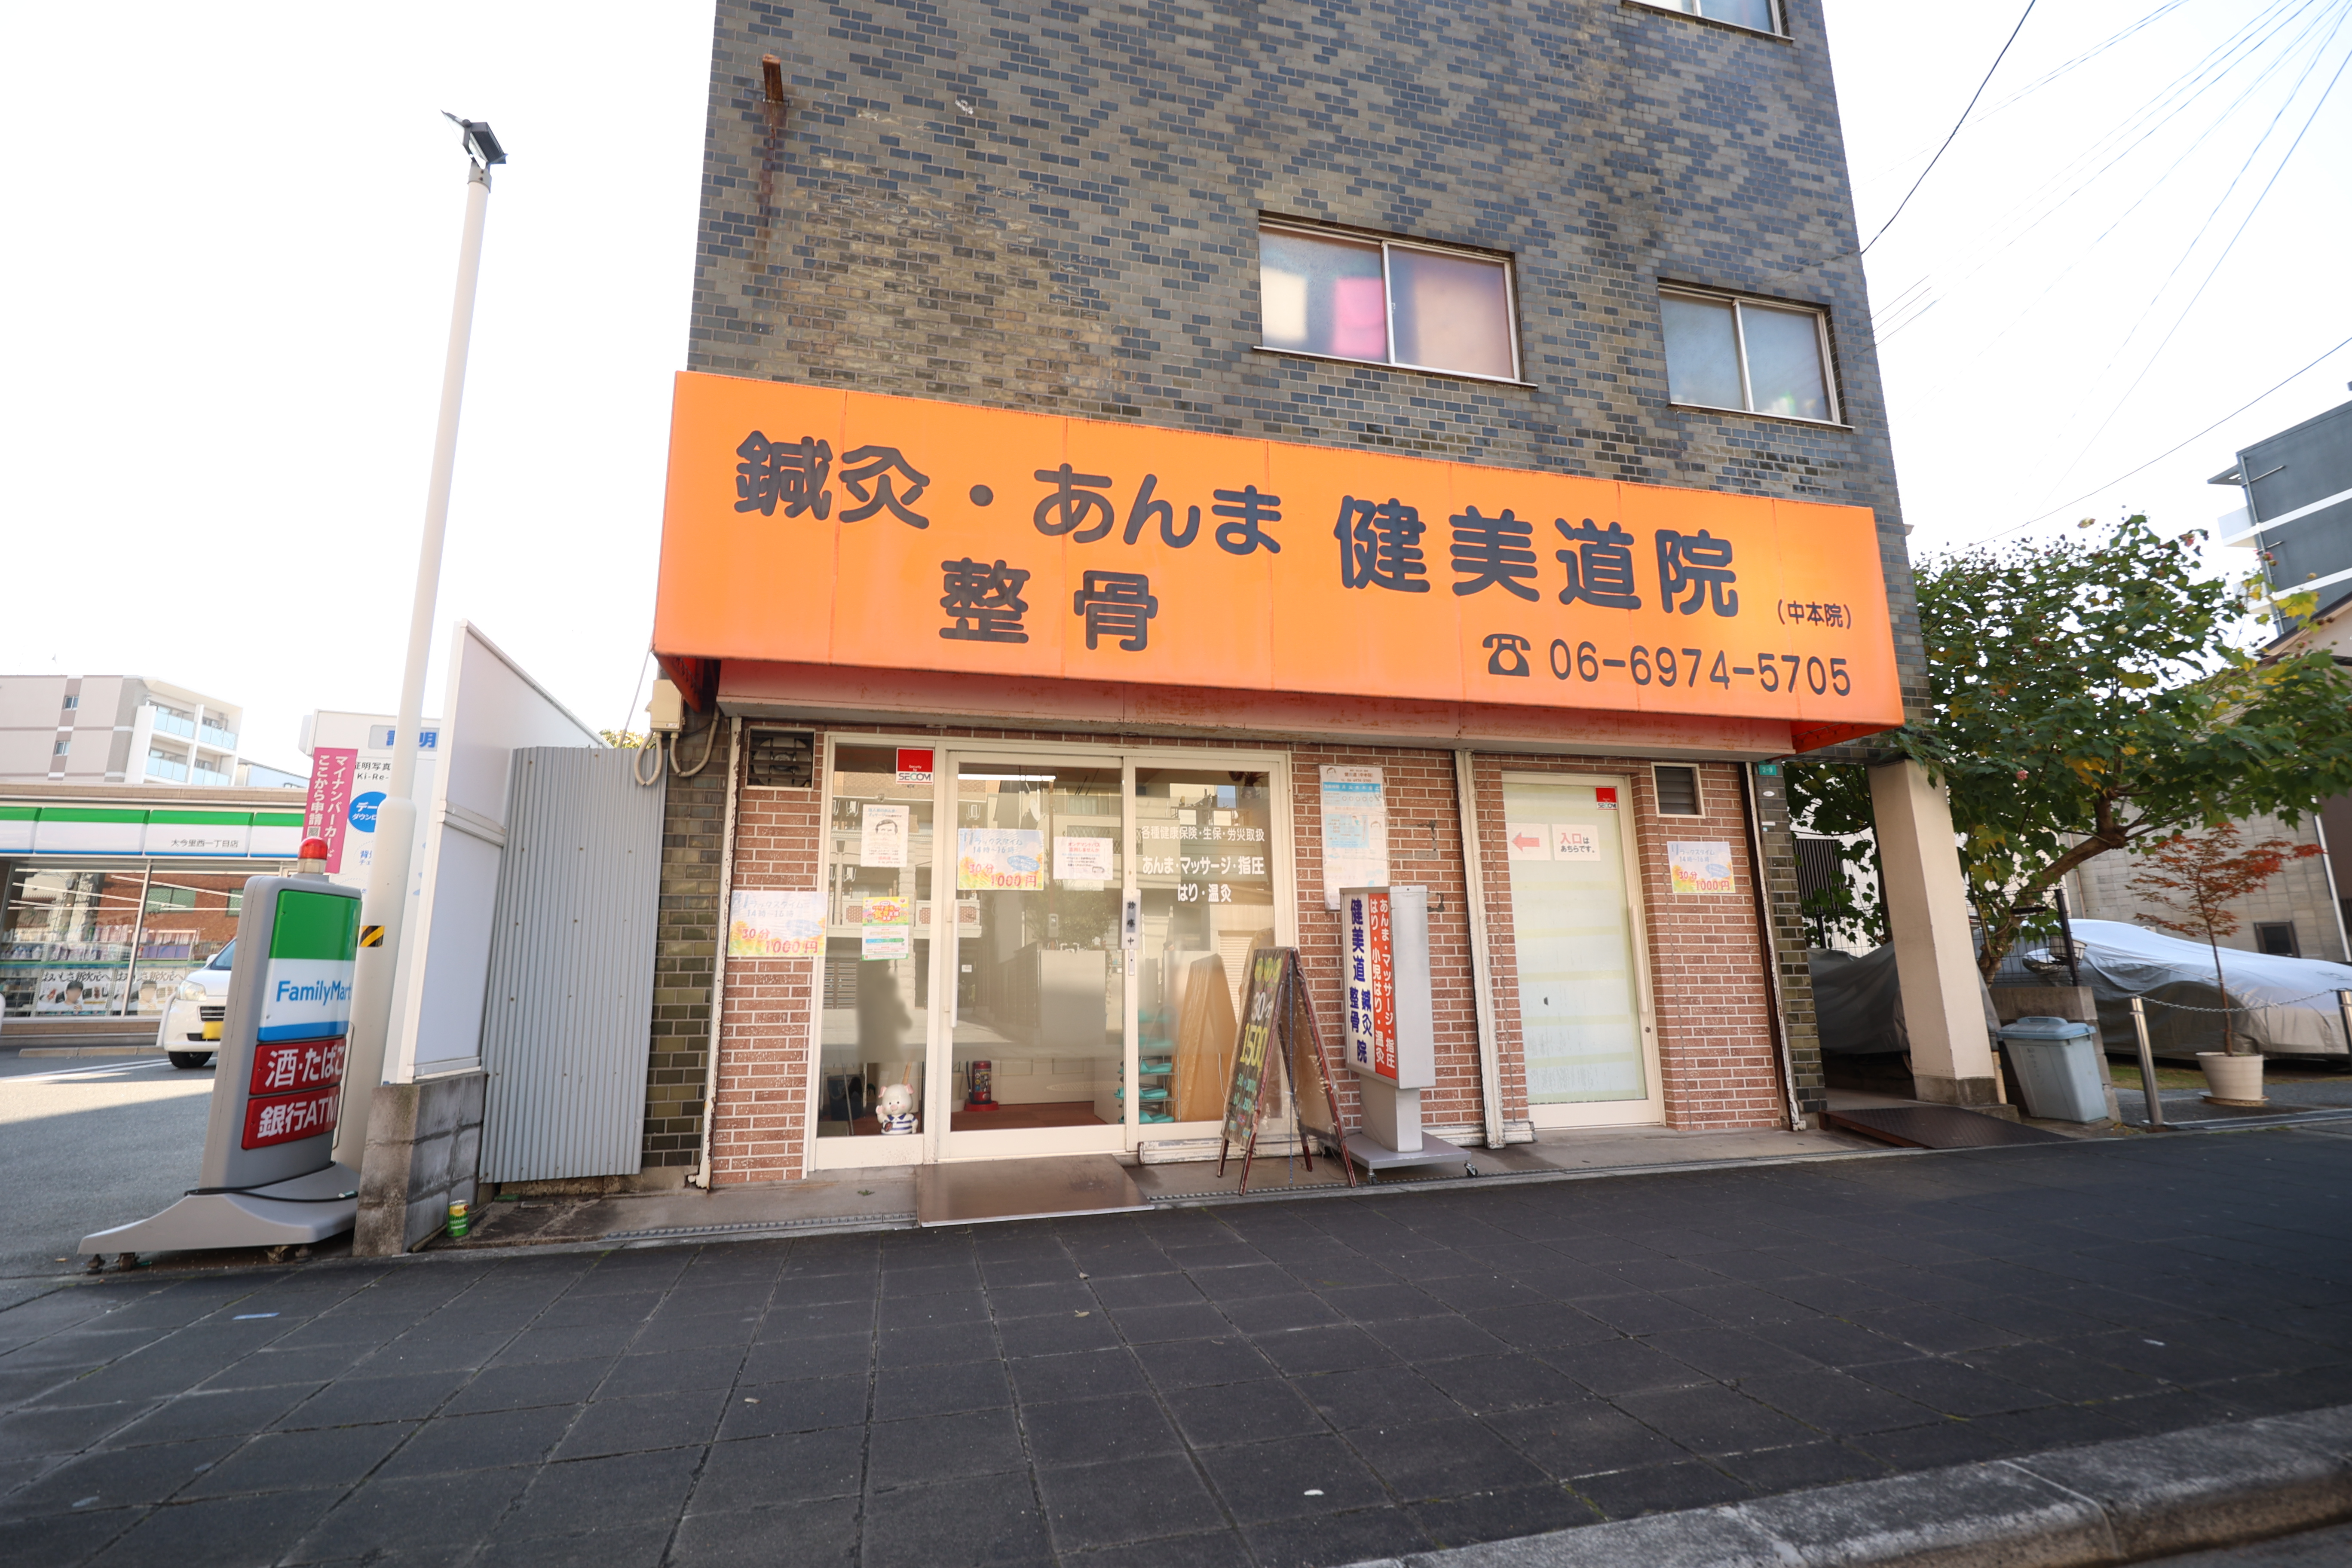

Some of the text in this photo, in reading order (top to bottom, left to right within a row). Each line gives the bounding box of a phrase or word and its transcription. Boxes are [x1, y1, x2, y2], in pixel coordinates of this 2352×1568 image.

[1334, 495, 1738, 617] 健美道院
[940, 557, 1158, 652] 整骨
[1550, 638, 1851, 697] 06-6974-5705
[899, 773, 931, 781] SECOM
[308, 755, 330, 826] ここから申請
[171, 839, 239, 848] 大今里西一丁目店
[1141, 826, 1265, 842] 各種健康保険・生保・労災取扱
[1142, 856, 1265, 875] あんま・マッサージ・指圧
[991, 875, 1037, 888] 1000円
[1696, 880, 1730, 891] 1000円
[1178, 883, 1232, 903] はり・温灸
[766, 940, 818, 954] 1000円
[276, 980, 351, 1006] FamilyMart
[1380, 899, 1395, 1069] あんま・マッサージ・指圧
[257, 1094, 338, 1139] 銀行ATM
